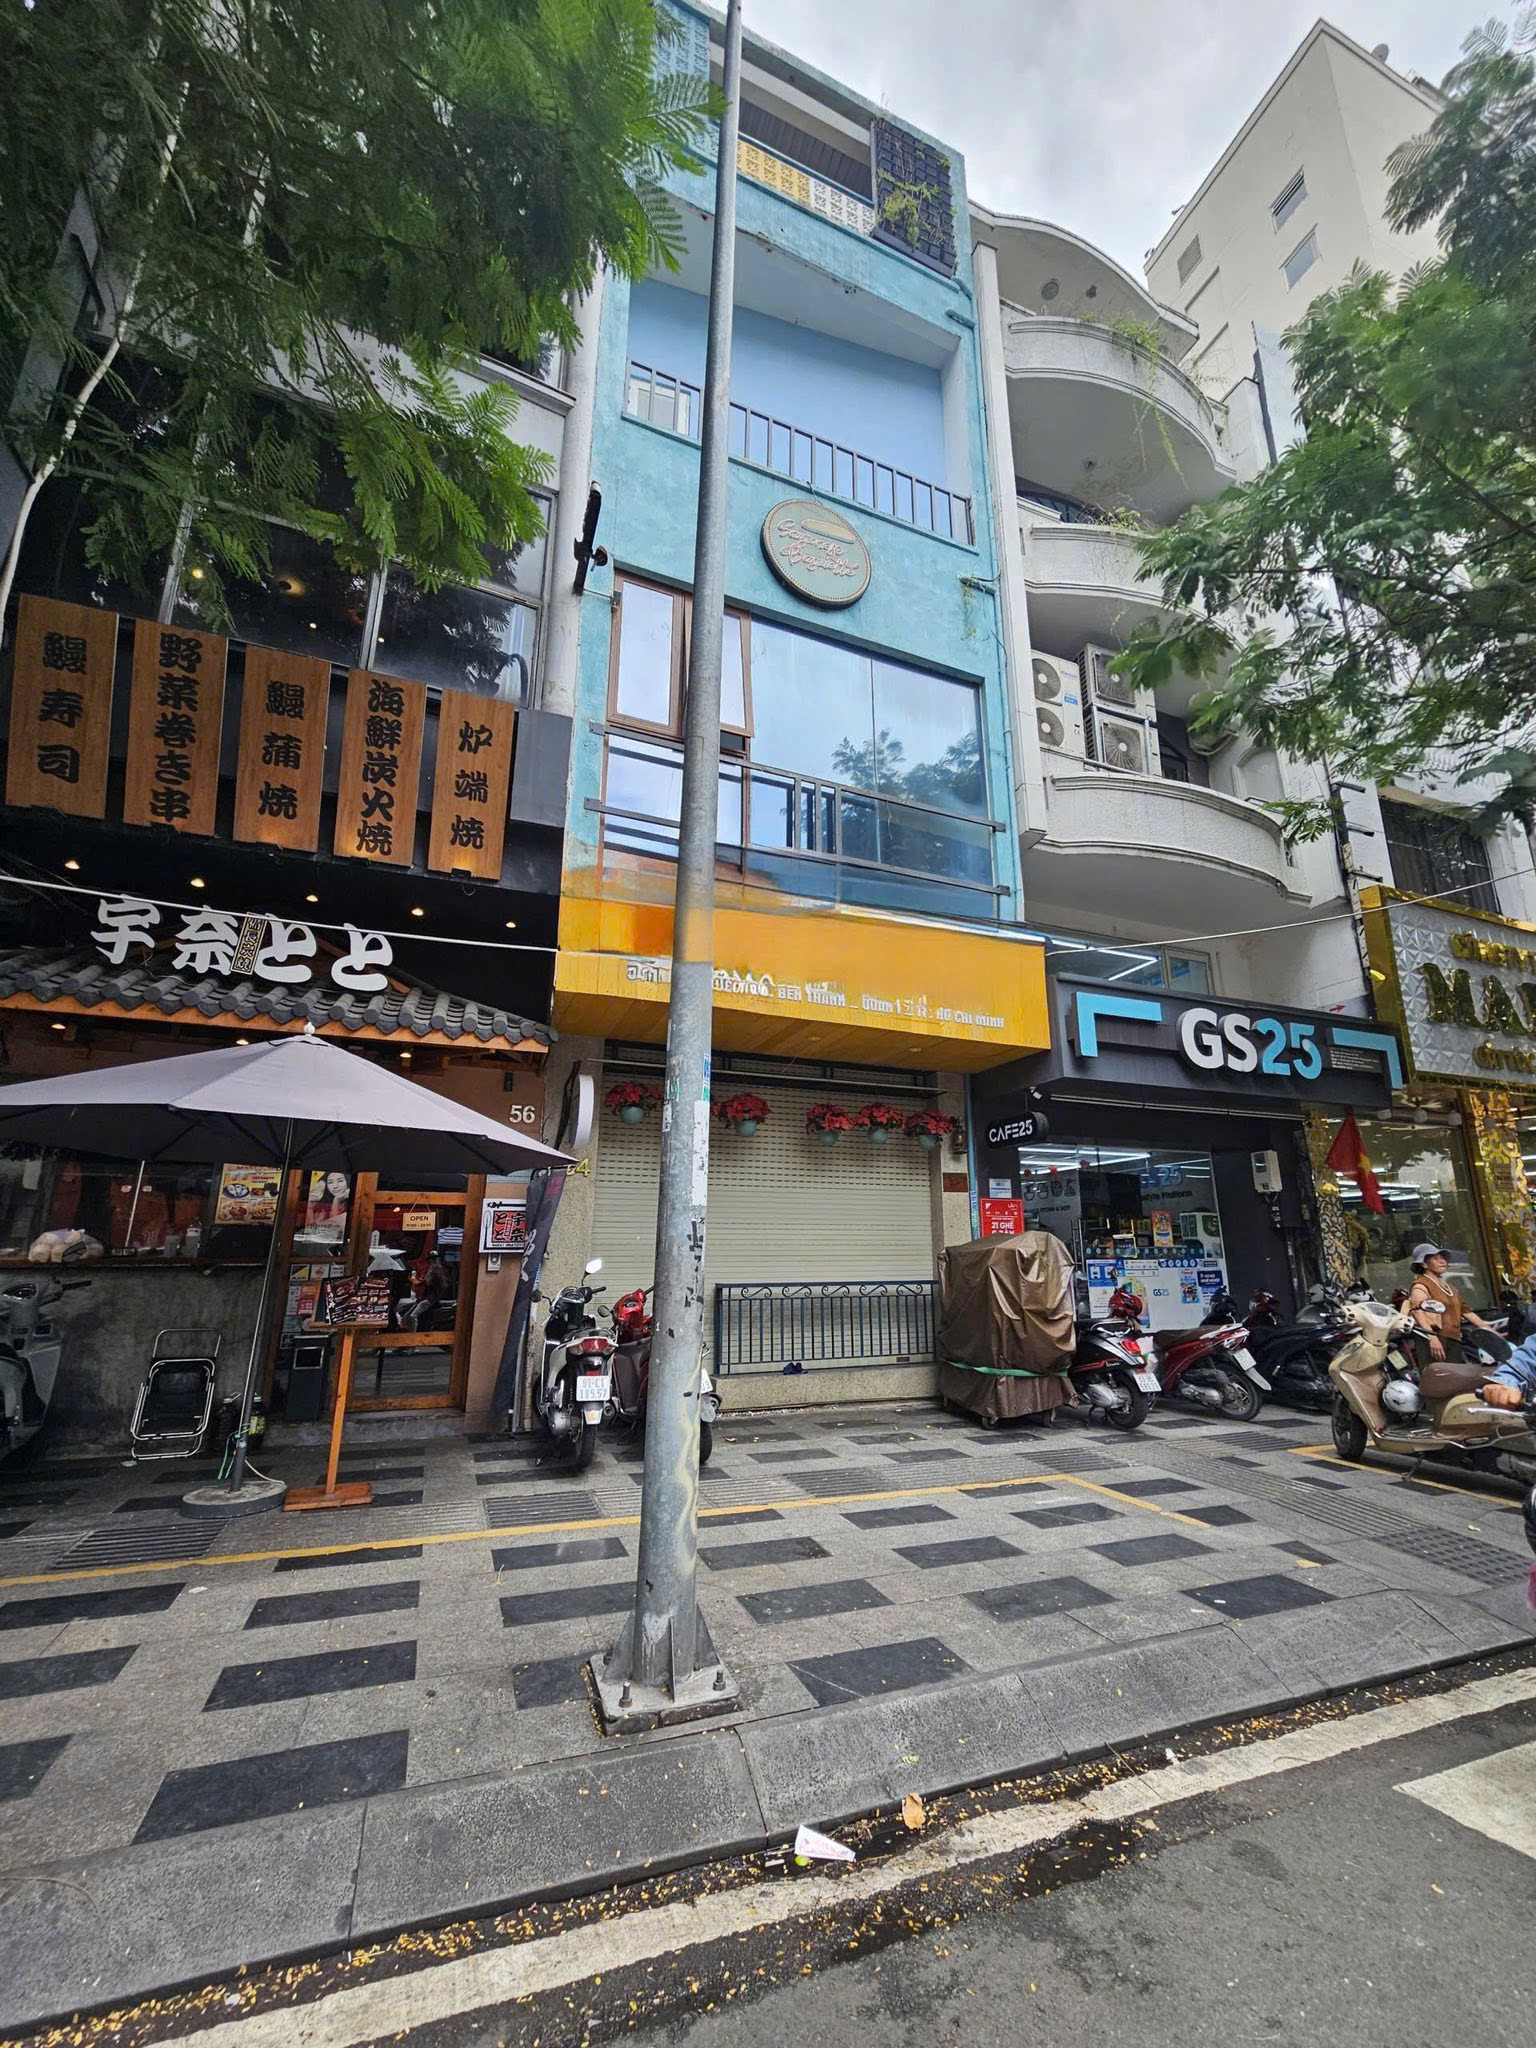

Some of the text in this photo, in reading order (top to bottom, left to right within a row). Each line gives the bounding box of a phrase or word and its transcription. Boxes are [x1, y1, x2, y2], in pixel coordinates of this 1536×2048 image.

[38, 631, 87, 784] 鰻寿司
[150, 632, 203, 823] 野菜巻き串
[258, 680, 305, 820] 鰻蒲焼
[356, 679, 404, 856] 海鮮炭火焼
[450, 721, 493, 850] 炉端焼
[91, 894, 393, 991] 宇奈とと
[1180, 1007, 1323, 1080] GS25
[509, 1105, 536, 1123] 56
[988, 1119, 1033, 1142] CAFE25
[1152, 1288, 1170, 1297] GS25
